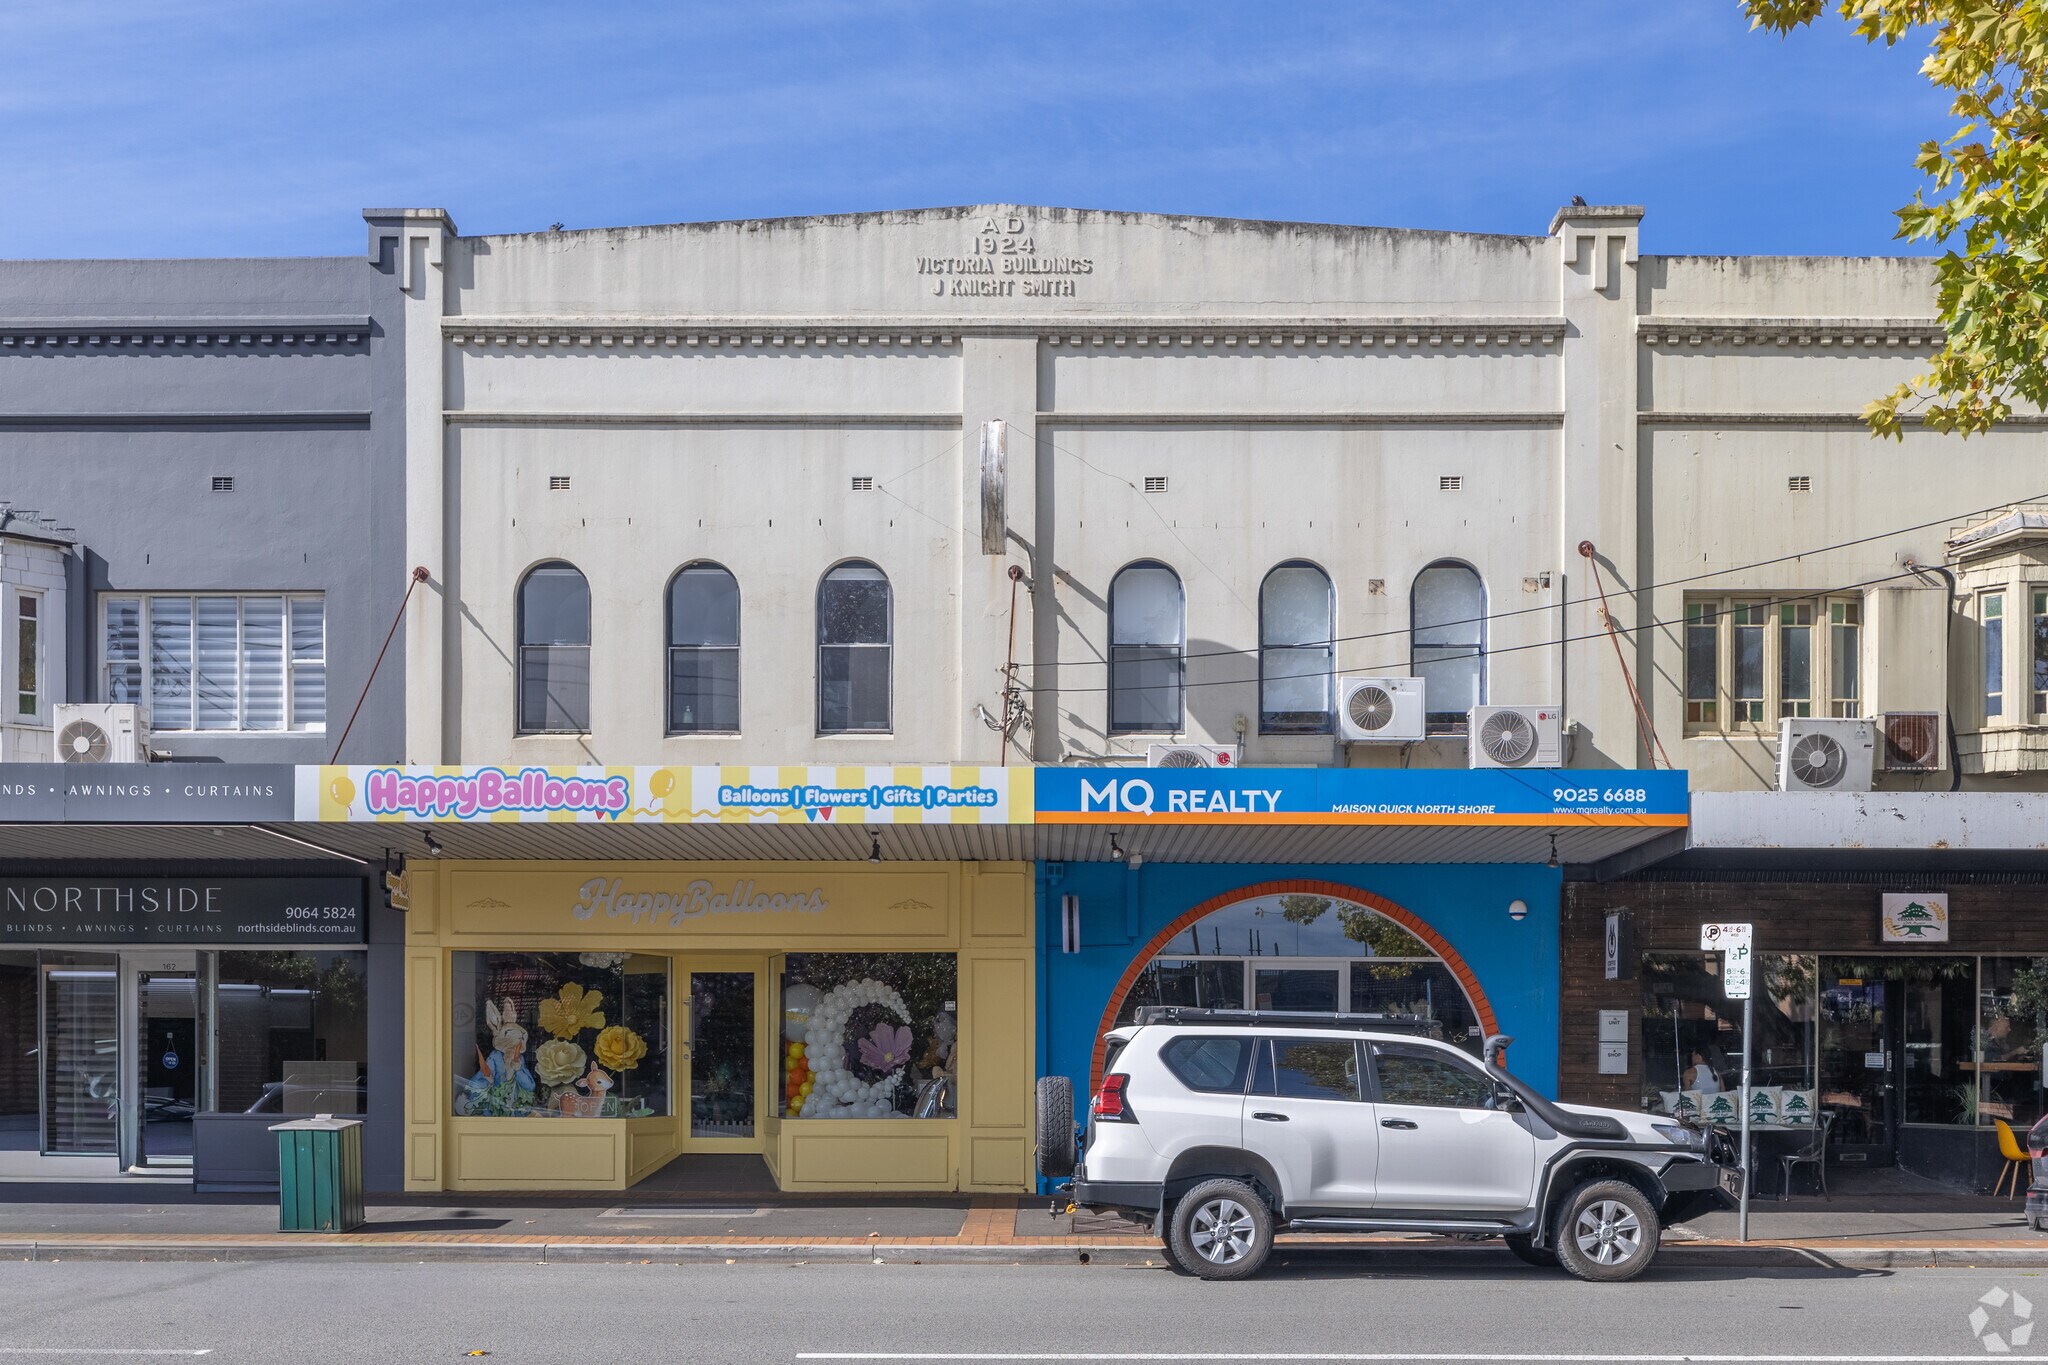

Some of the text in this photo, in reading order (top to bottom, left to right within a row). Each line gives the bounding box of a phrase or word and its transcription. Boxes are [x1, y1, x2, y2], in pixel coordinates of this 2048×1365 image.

[972, 236, 1036, 255] 1924
[915, 256, 1094, 275] VICTORIA BUILDINGS
[931, 278, 1076, 297] J KNIGHT SMITH
[68, 784, 152, 797] AWNINGS
[184, 785, 274, 797] CURTAINS
[368, 770, 627, 817] HappyBalloons
[721, 789, 995, 804] Balloons Flowers Gifts Parties
[1081, 778, 1282, 816] MQ REALTY
[1553, 788, 1647, 802] 9025 6688
[1332, 804, 1496, 814] MAISON QUICK NORTH SHORE
[1553, 806, 1647, 815] www.mqrealty.com.au
[6, 887, 222, 913] NORTHSIDE
[572, 877, 829, 928] HappyBalloons
[285, 907, 356, 919] 9064 5824
[6, 924, 222, 933] BLINDS AWNINGS CURTAINS
[237, 922, 356, 934] northsideblinds.com.au
[162, 963, 176, 971] 162
